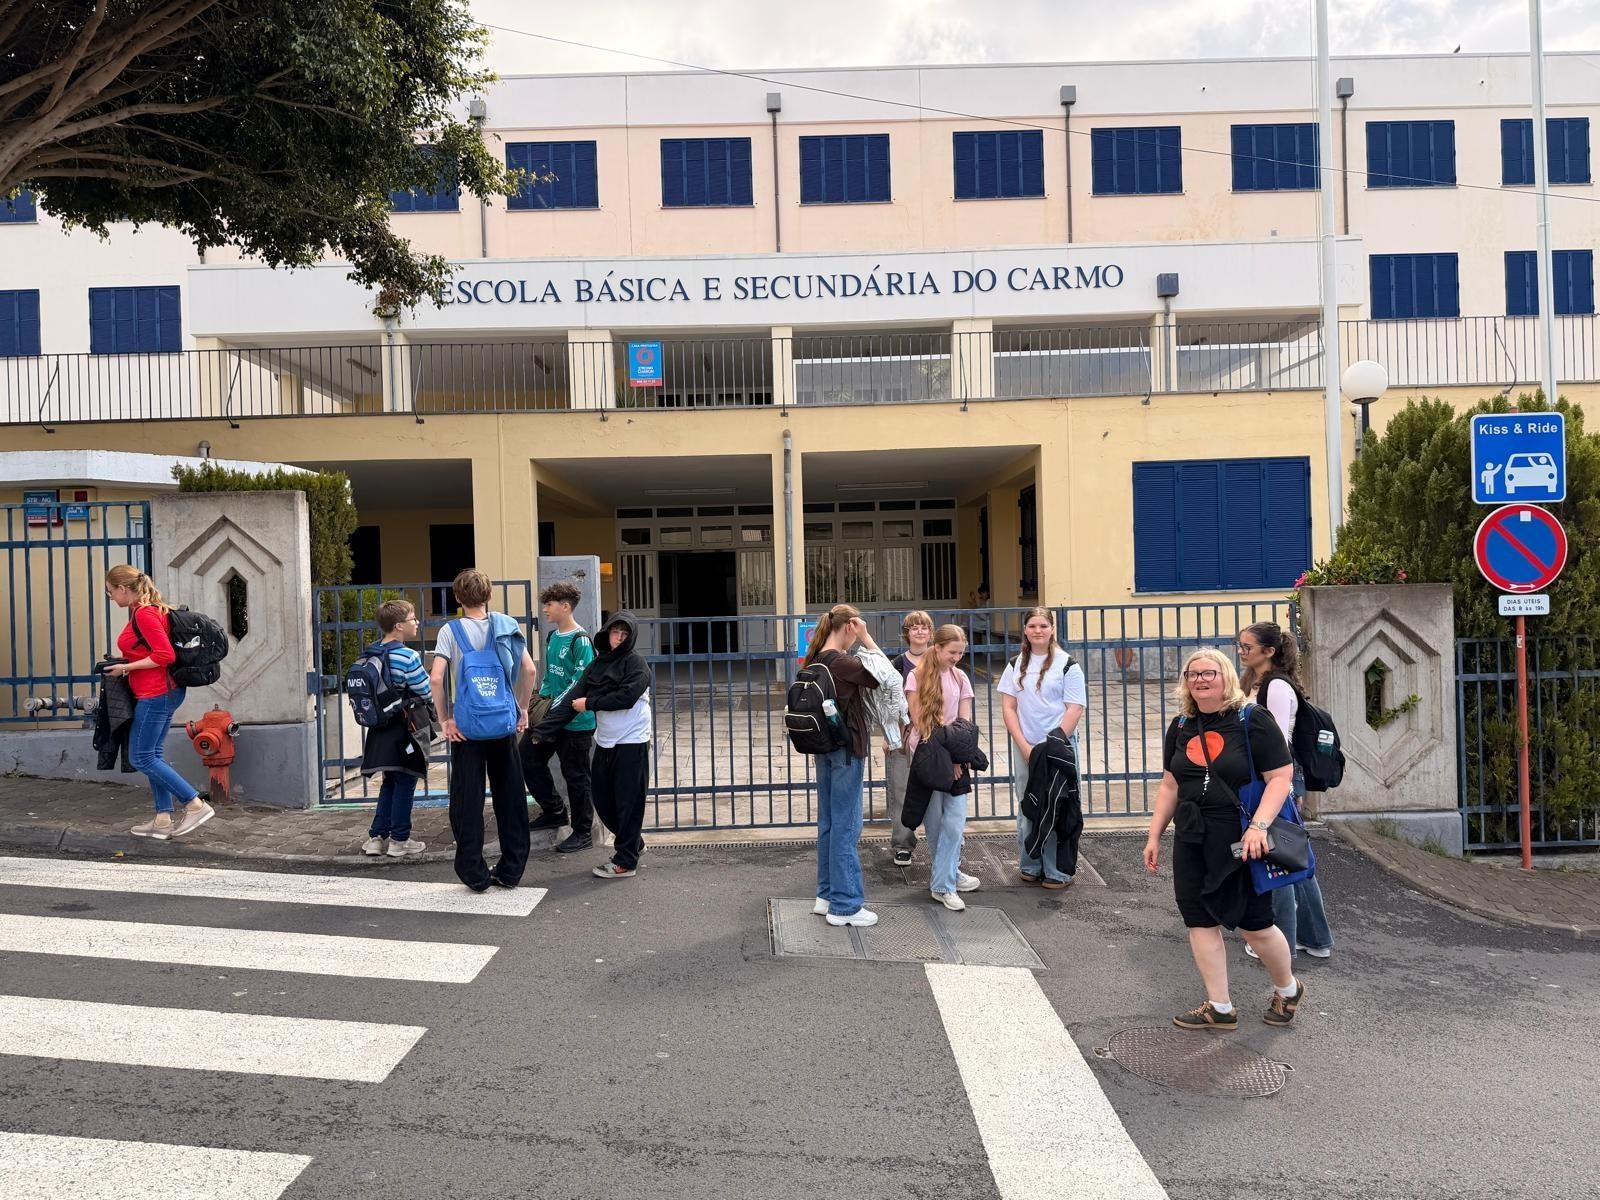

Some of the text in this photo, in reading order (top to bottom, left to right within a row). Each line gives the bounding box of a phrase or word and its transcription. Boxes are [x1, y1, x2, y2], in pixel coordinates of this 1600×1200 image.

[439, 264, 1124, 304] ESCOLA BÁSICA E SECUNDÁRIA DO CARMO
[1479, 422, 1558, 435] Kiss & Ride
